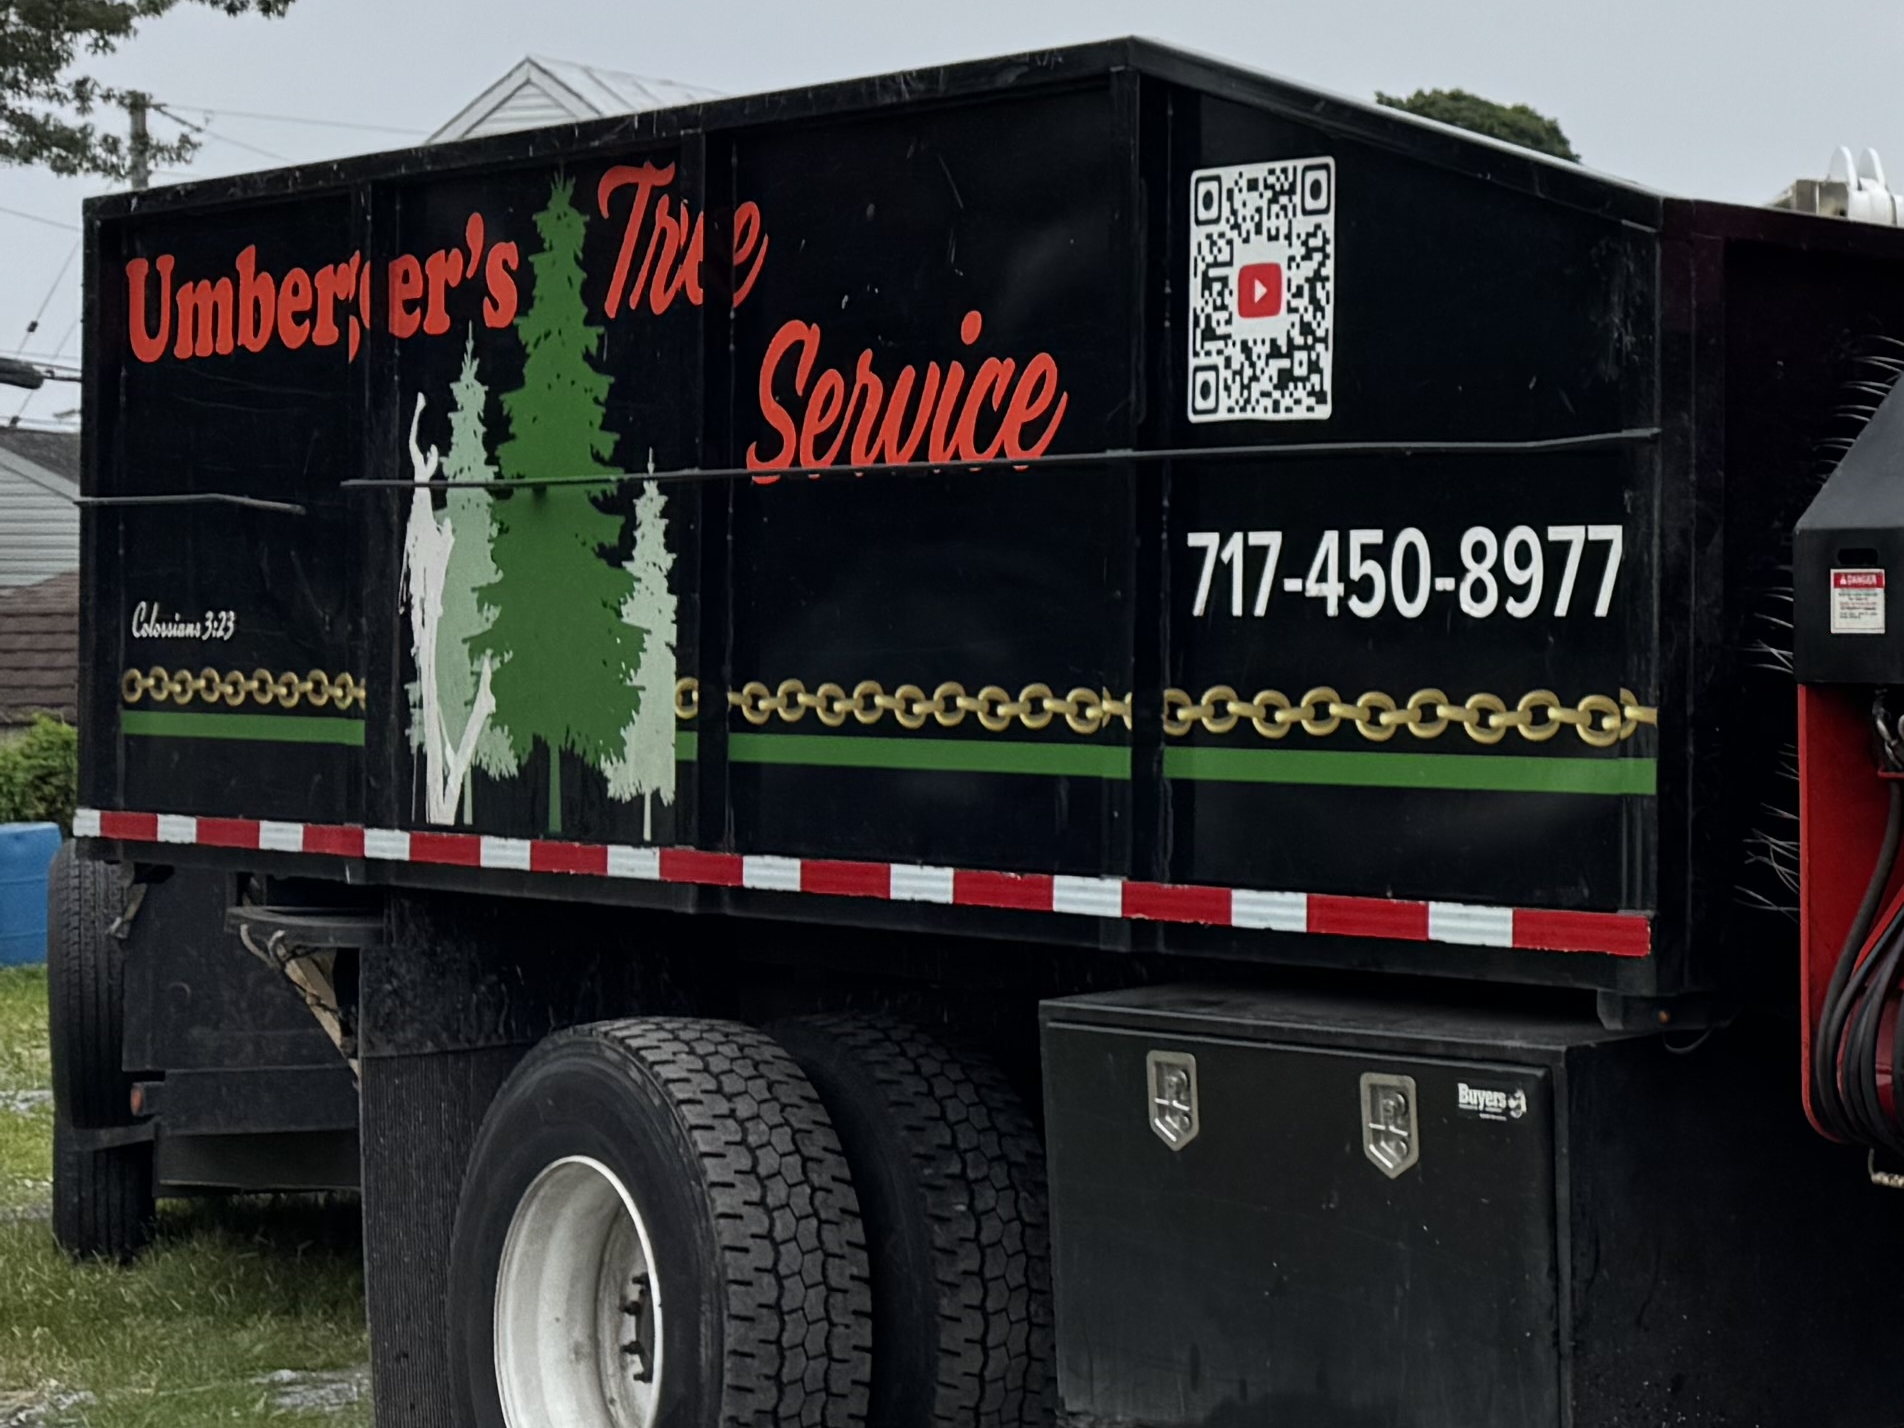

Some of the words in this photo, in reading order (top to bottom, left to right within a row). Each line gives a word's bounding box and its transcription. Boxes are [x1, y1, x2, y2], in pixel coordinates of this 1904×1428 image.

[746, 310, 1068, 484] Service
[1187, 524, 1623, 619] 717-450-8977
[131, 600, 201, 639] Colossians
[202, 610, 236, 641] 3:23
[1457, 1082, 1507, 1111] Buyers
